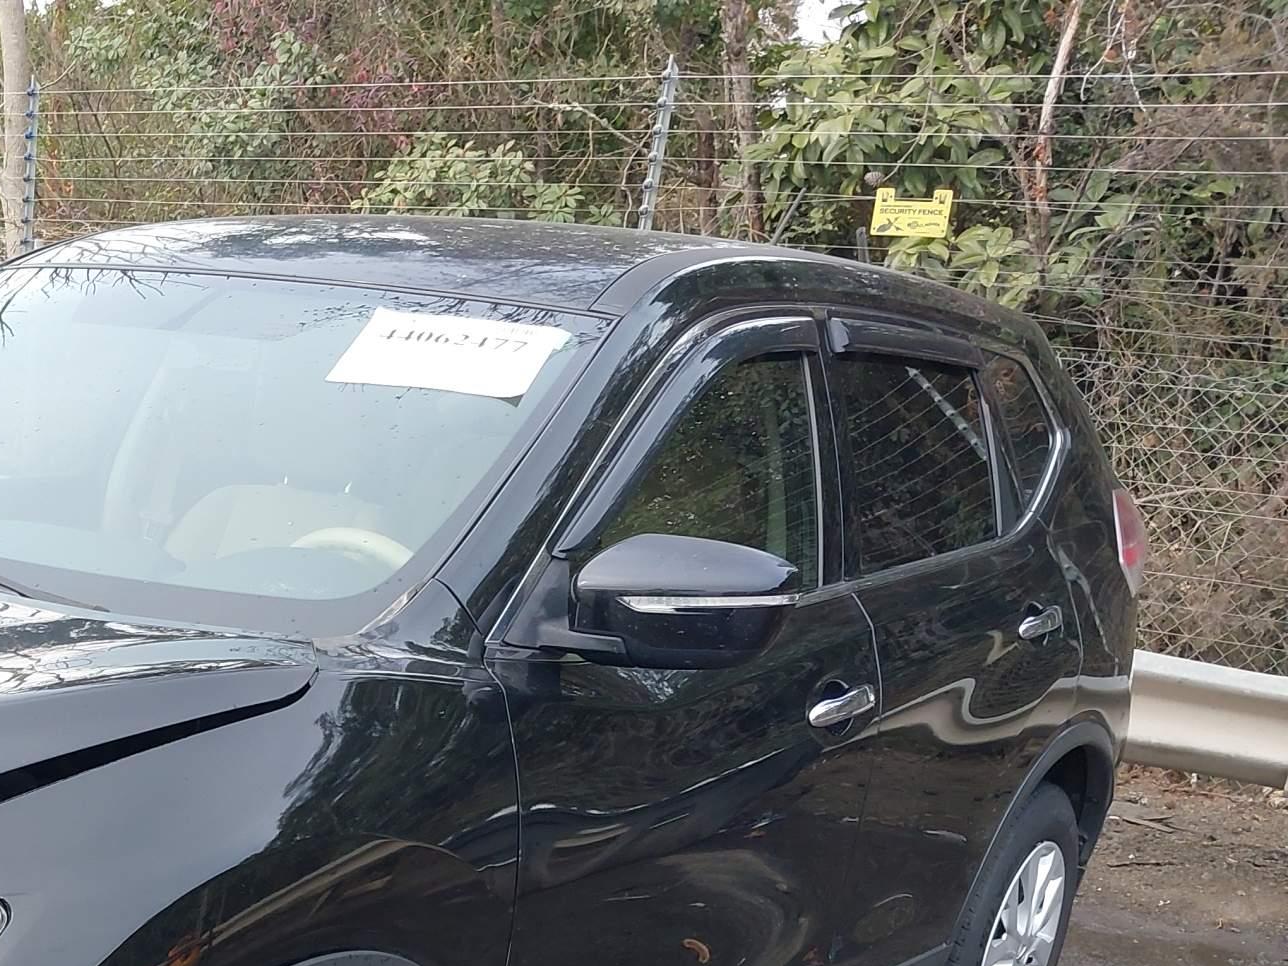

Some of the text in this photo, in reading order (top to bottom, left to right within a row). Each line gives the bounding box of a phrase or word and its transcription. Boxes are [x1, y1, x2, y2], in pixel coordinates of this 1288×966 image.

[879, 208, 945, 217] SECURITY FENCE
[378, 328, 530, 354] 44062477
